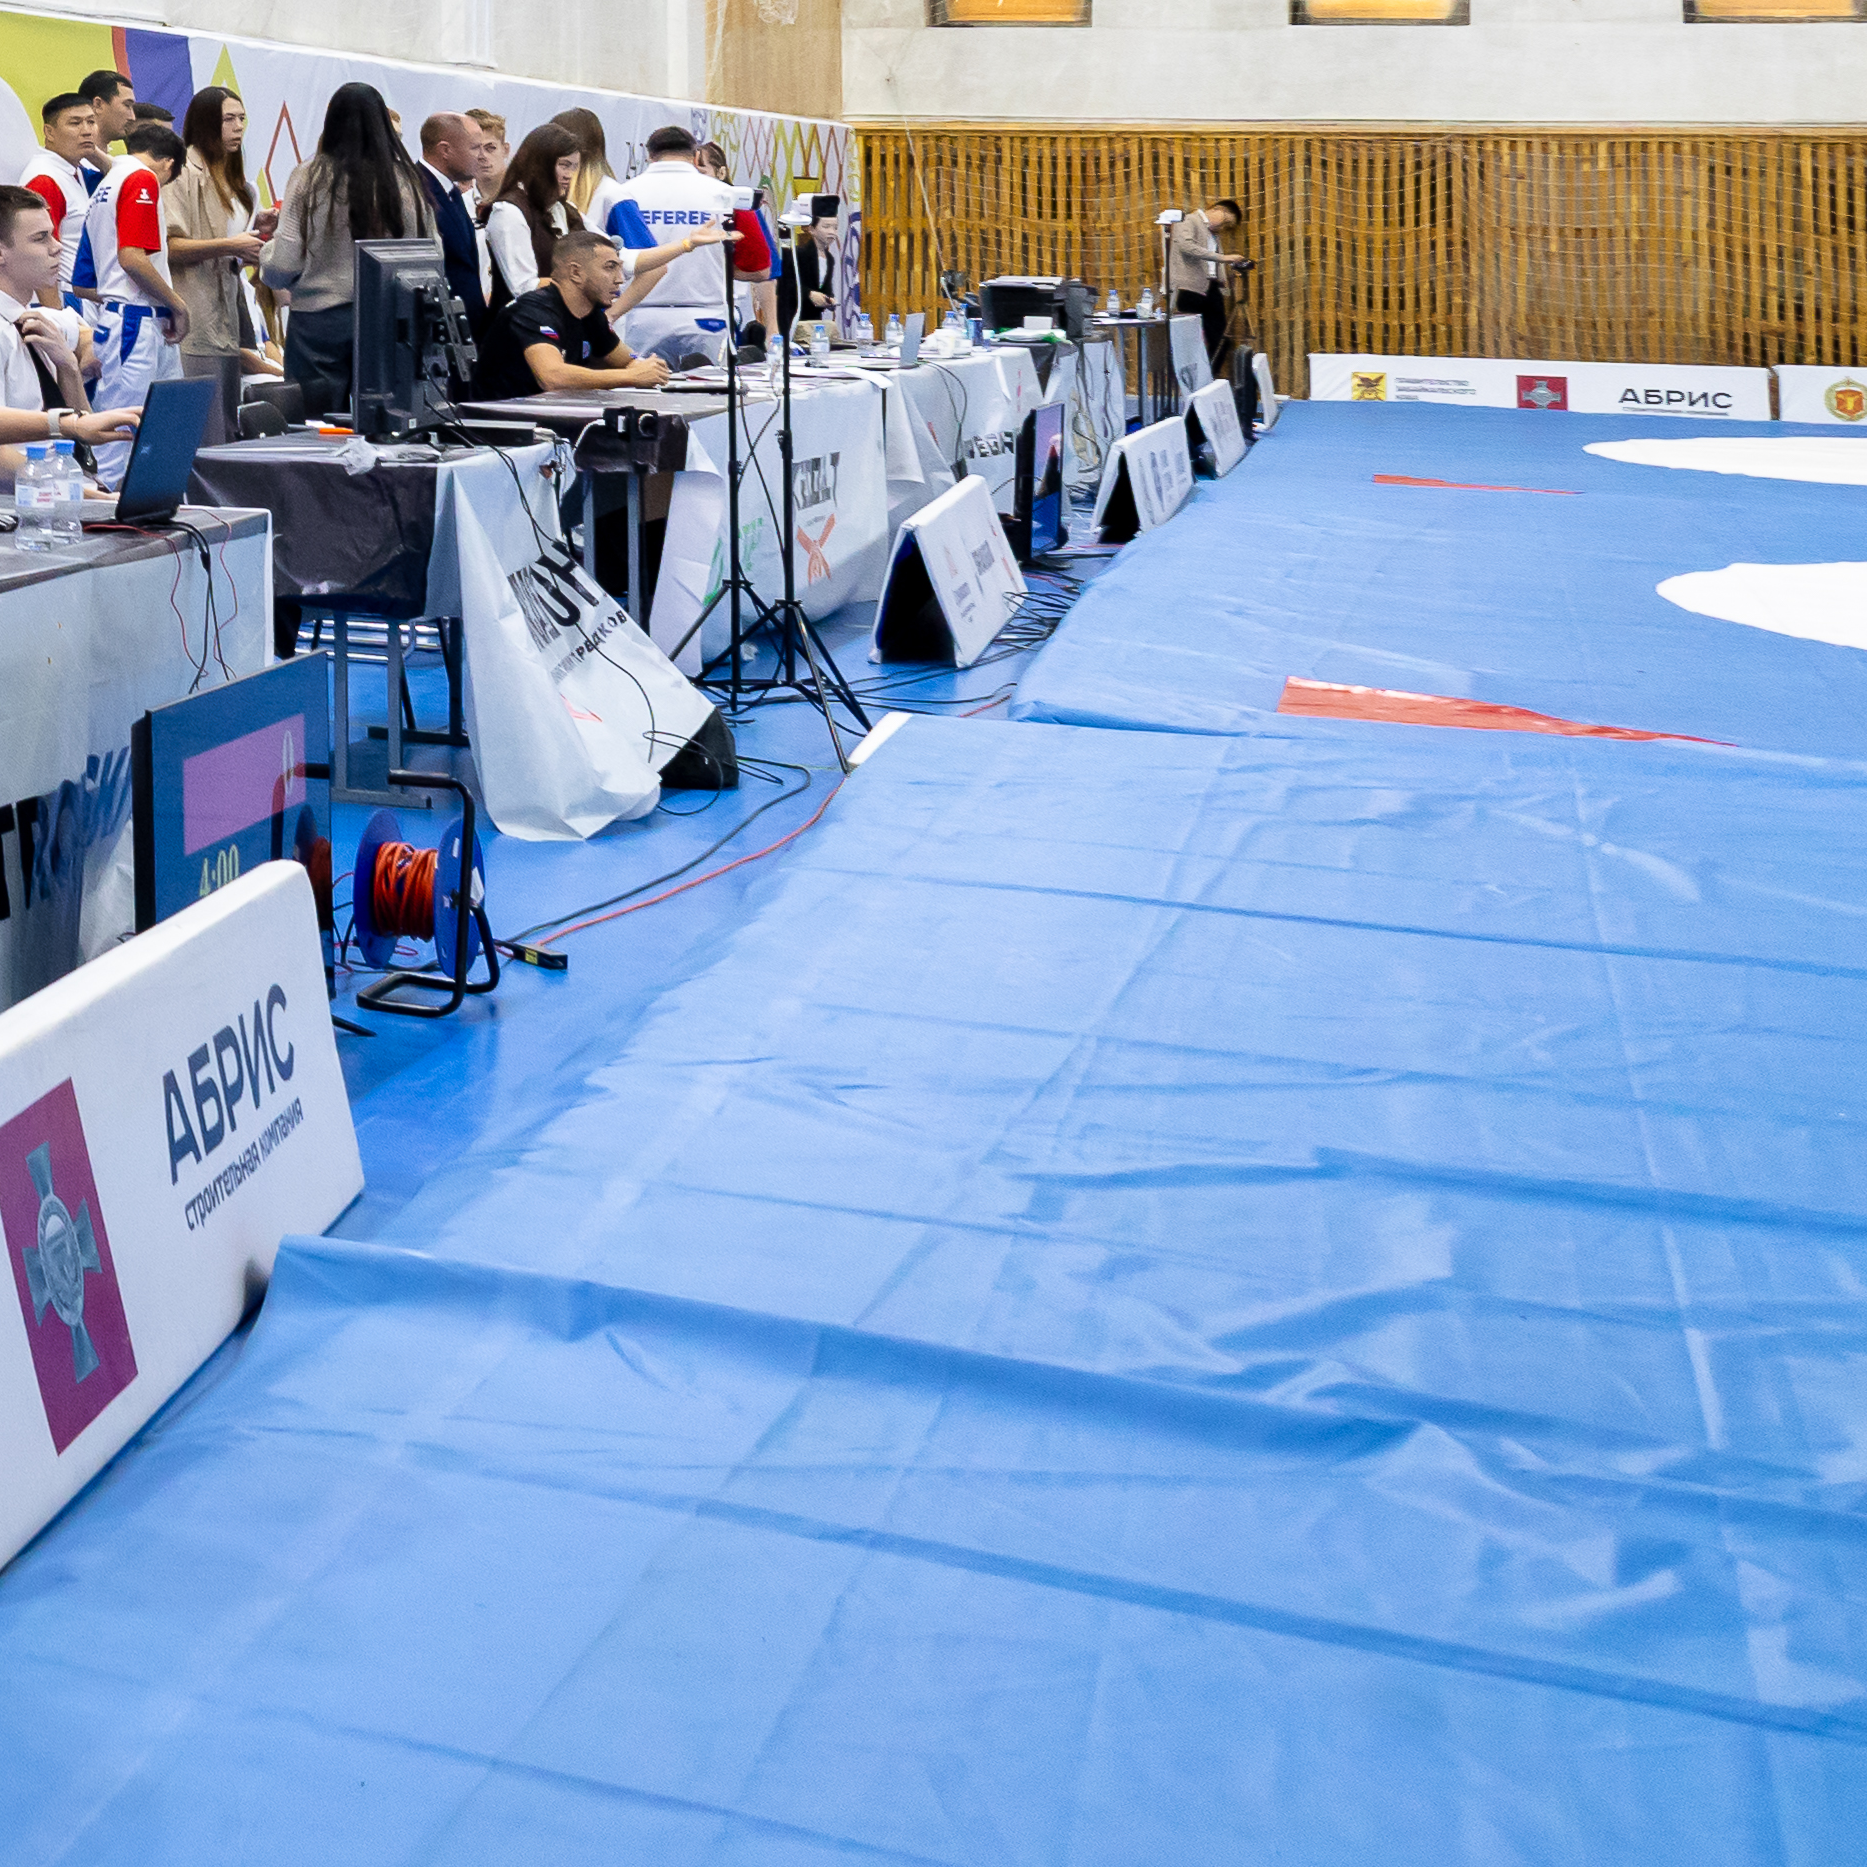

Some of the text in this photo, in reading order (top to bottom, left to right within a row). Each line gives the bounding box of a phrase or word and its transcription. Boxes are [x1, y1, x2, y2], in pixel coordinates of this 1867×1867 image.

[639, 210, 712, 225] EFEREE
[1618, 387, 1733, 409] АБРИС
[163, 983, 295, 1185] АБРИС
